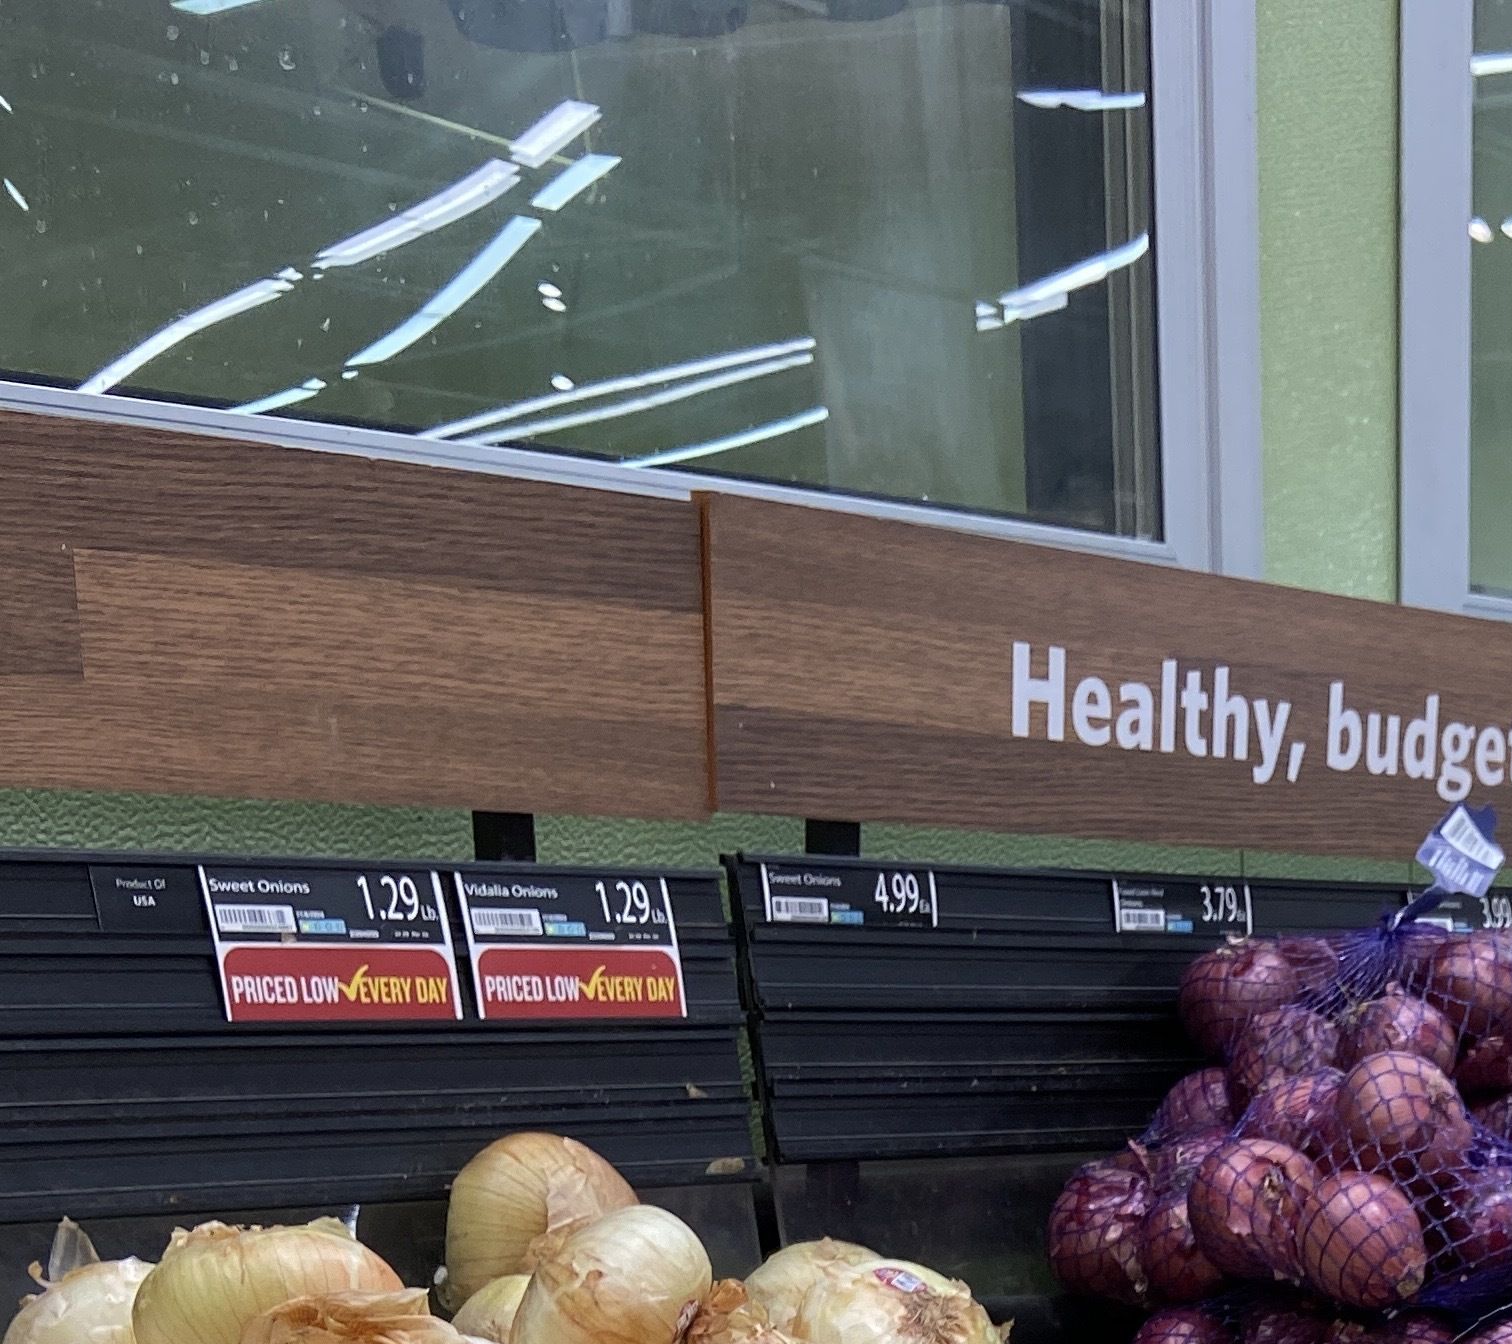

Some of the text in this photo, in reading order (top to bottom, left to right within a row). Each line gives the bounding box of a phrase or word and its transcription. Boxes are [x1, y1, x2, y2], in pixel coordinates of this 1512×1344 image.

[1010, 641, 1307, 785] Healthy,
[115, 878, 166, 890] Product Of
[133, 895, 156, 907] USA
[208, 877, 255, 893] Sweet
[257, 880, 311, 895] Onions
[356, 875, 420, 922] 1.29
[464, 883, 509, 898] Vidalia
[511, 884, 559, 899] Onions
[595, 879, 652, 924] 1.29
[768, 871, 801, 885] Sweet
[803, 872, 842, 887] Onions
[874, 872, 919, 913] 4.99
[1200, 886, 1238, 922] 3.79
[231, 974, 448, 1005] PRICED LOW EVERY DAY
[485, 975, 675, 1003] PRICED LOW EVERY DAY
